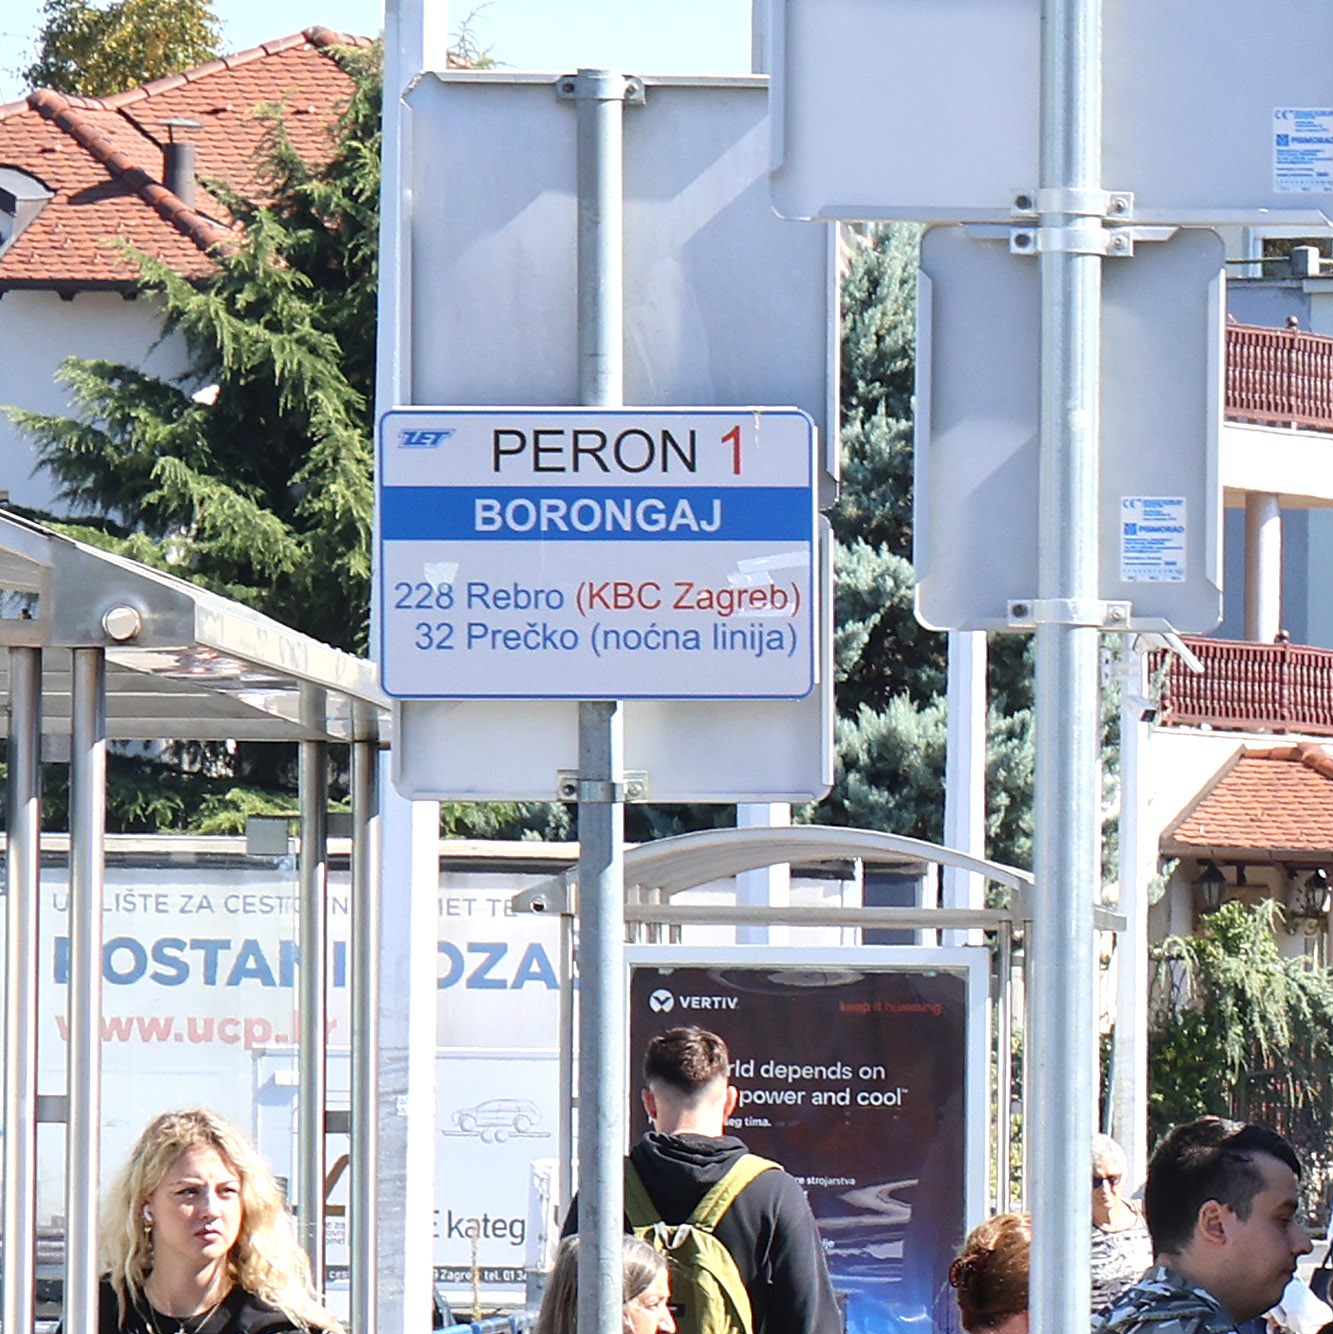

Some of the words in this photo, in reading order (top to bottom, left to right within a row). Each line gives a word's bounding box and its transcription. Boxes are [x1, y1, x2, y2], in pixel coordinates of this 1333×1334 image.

[492, 428, 697, 473] PERON
[720, 424, 741, 475] 1
[474, 498, 722, 532] BORONGAJ
[393, 582, 455, 610] 228
[467, 581, 565, 610] Rebro
[576, 581, 661, 617] (KBC
[673, 581, 801, 617] Zagreb)
[415, 622, 454, 651] 32
[467, 621, 579, 651] Prečko
[590, 621, 700, 658] (noćna
[712, 621, 798, 658] linija)
[52, 888, 169, 914] ULIŠTE
[178, 893, 215, 915] ZA
[437, 941, 580, 991] OZA
[679, 995, 738, 1010] VERTIV
[726, 1060, 754, 1079] rld
[760, 1060, 852, 1083] depends
[858, 1066, 886, 1080] on
[738, 1090, 805, 1107] power
[811, 1089, 850, 1106] and
[440, 1268, 473, 1283] Zagre
